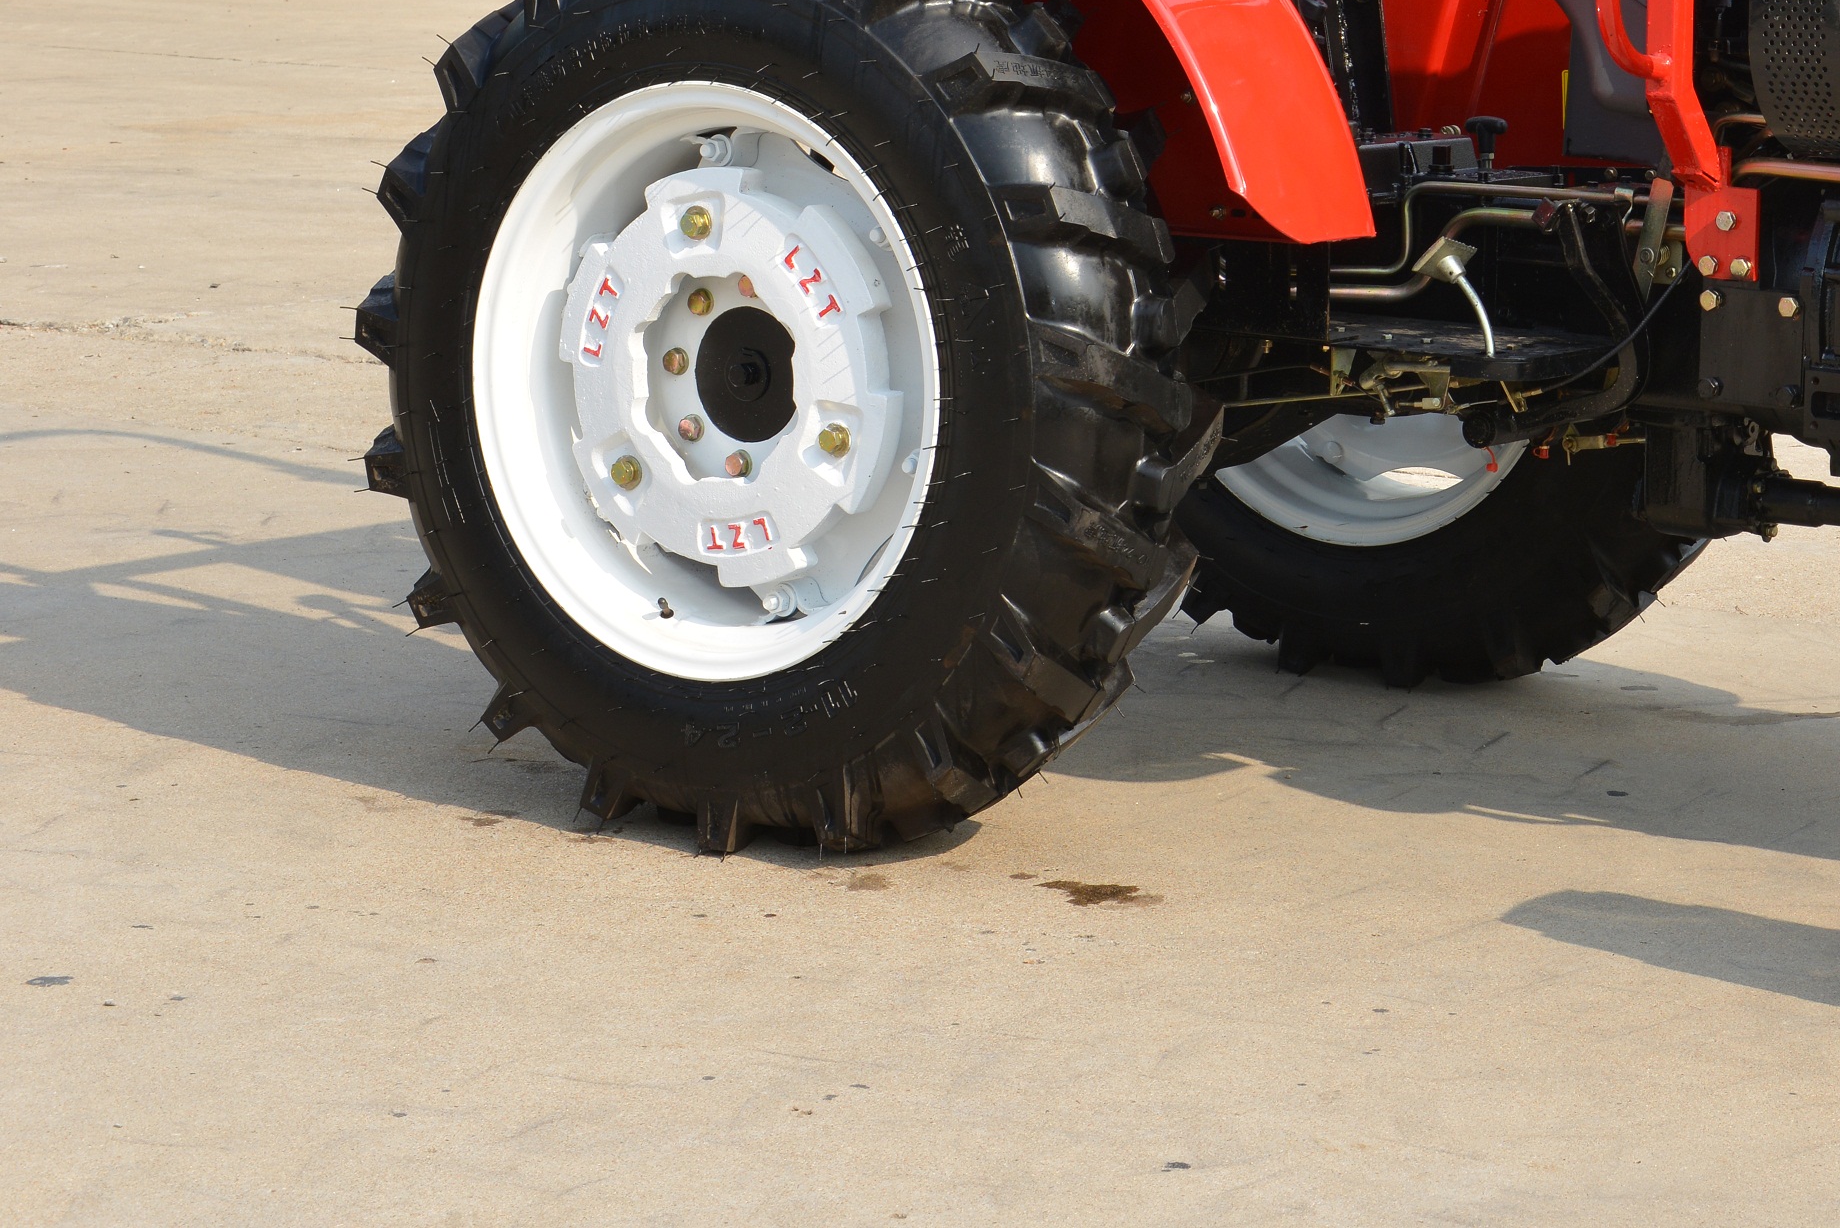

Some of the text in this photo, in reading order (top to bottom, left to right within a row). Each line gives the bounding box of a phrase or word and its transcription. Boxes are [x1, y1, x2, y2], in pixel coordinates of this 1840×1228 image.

[584, 276, 619, 359] LZT
[784, 245, 843, 319] LZT
[706, 517, 773, 551] LZT
